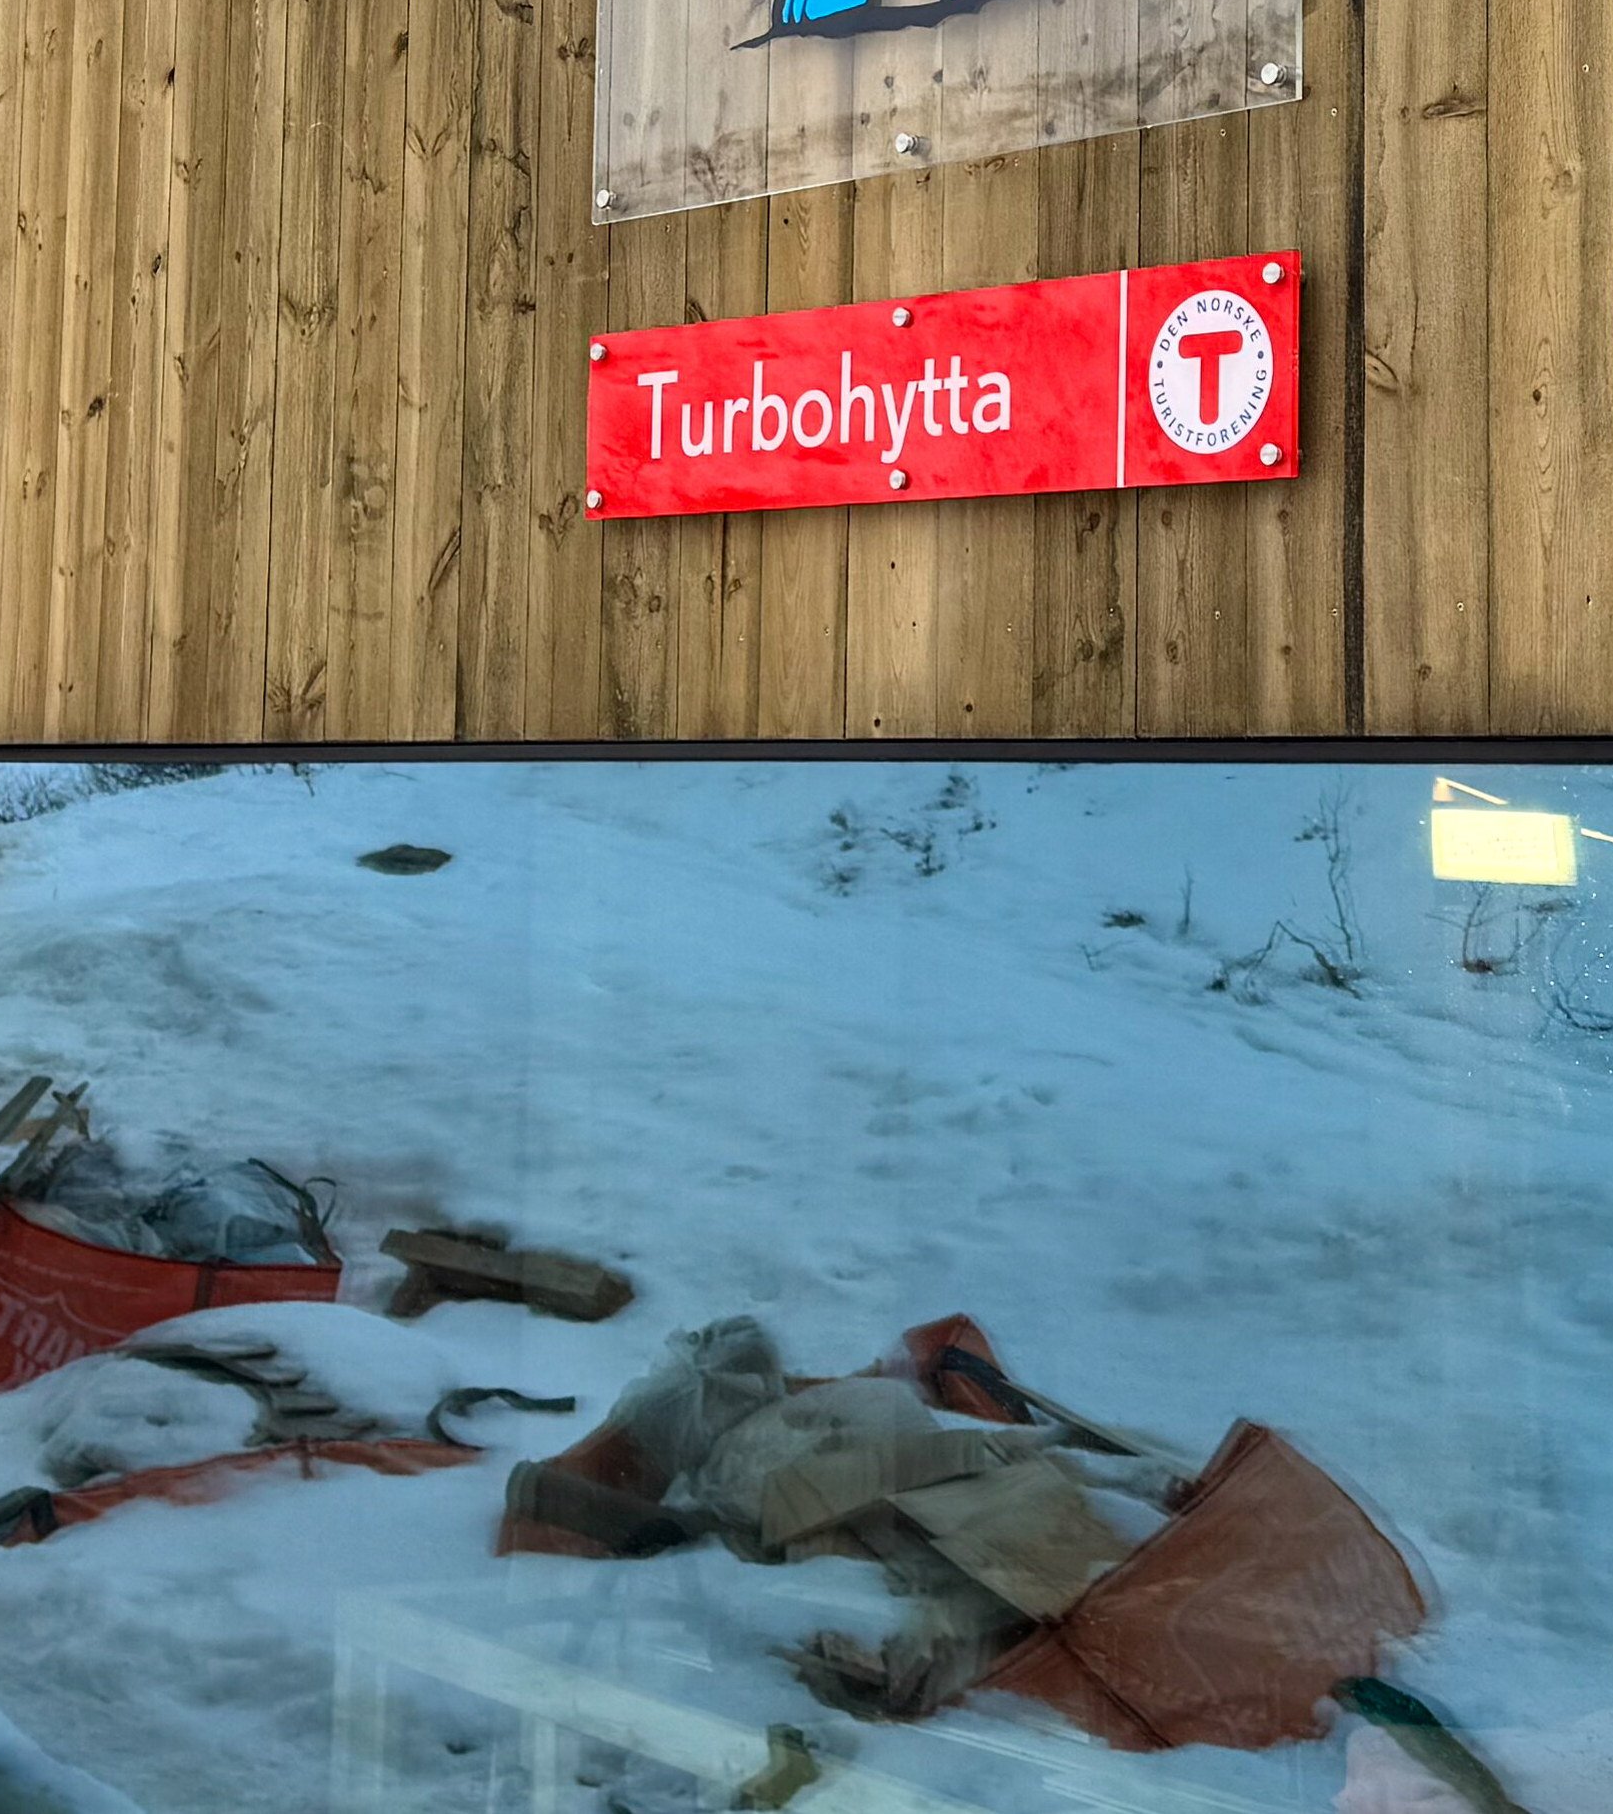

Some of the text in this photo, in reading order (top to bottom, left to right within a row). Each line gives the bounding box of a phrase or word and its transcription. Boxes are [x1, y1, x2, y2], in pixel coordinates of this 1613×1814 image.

[1159, 297, 1262, 352] DEN NORSKE
[637, 351, 1012, 463] Turbohytta
[1153, 368, 1268, 448] TURISTFORENING
[1178, 330, 1244, 425] T
